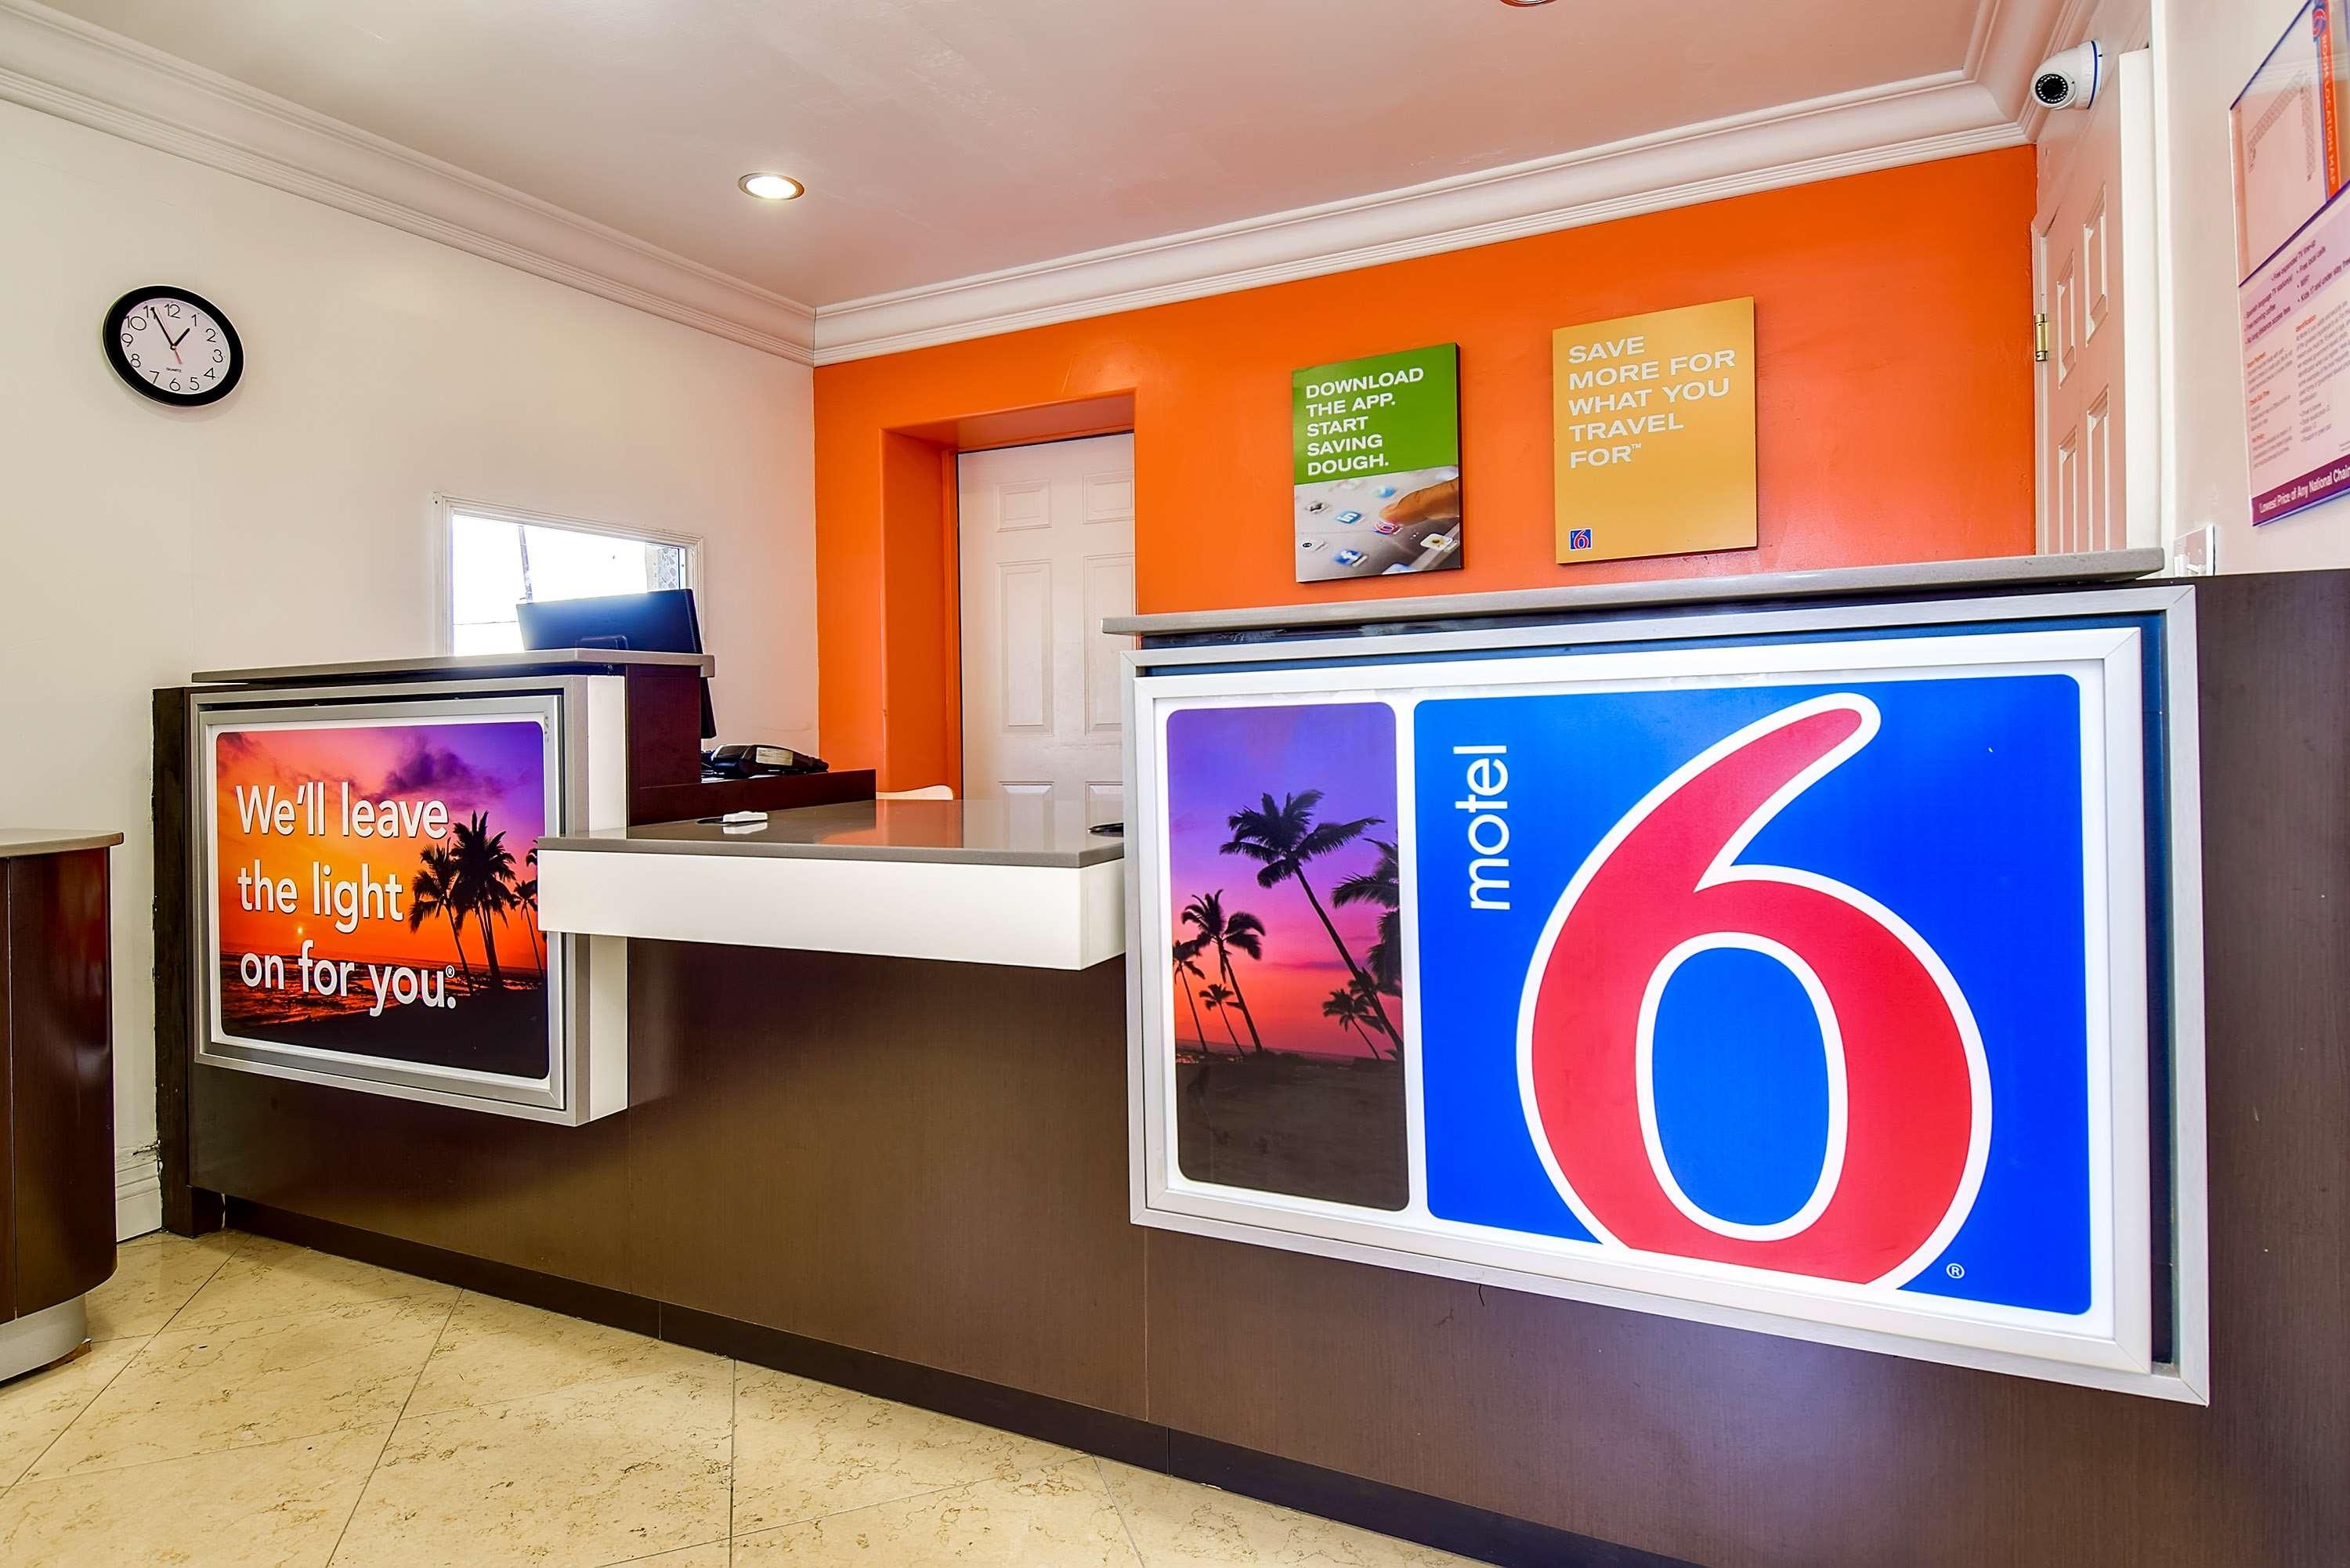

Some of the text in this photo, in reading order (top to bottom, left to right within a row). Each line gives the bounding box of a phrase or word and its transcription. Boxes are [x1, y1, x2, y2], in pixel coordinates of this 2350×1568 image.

[2324, 81, 2334, 152] LOCATION
[164, 304, 181, 319] 12
[191, 314, 197, 327] 1
[125, 316, 146, 331] 10
[121, 333, 133, 347] 9
[205, 328, 216, 342] 2
[212, 349, 223, 363] 3
[1568, 335, 1645, 363] SAVE
[130, 353, 141, 368] 8
[1569, 349, 1736, 390] MORE FOR
[150, 370, 160, 384] 7
[190, 377, 200, 391] 5
[204, 367, 215, 380] 4
[1306, 367, 1423, 399] DOWNLOAD
[169, 378, 181, 392] 6
[1306, 392, 1396, 417] THE APP.
[1568, 378, 1730, 416] WHAT YOU
[1307, 416, 1368, 437] START
[1568, 413, 1683, 443] TRAVEL
[1307, 434, 1383, 456] SAVING
[1307, 453, 1389, 475] DOUGH.
[2276, 493, 2290, 506] Price
[2290, 487, 2297, 500] of
[2297, 485, 2308, 498] Any
[2309, 471, 2333, 493] National
[236, 782, 449, 839] We'll leave
[1453, 745, 1510, 910] motel
[237, 858, 403, 934] the light
[240, 952, 284, 990] on
[298, 940, 355, 997] for
[1516, 692, 1992, 1290] 6
